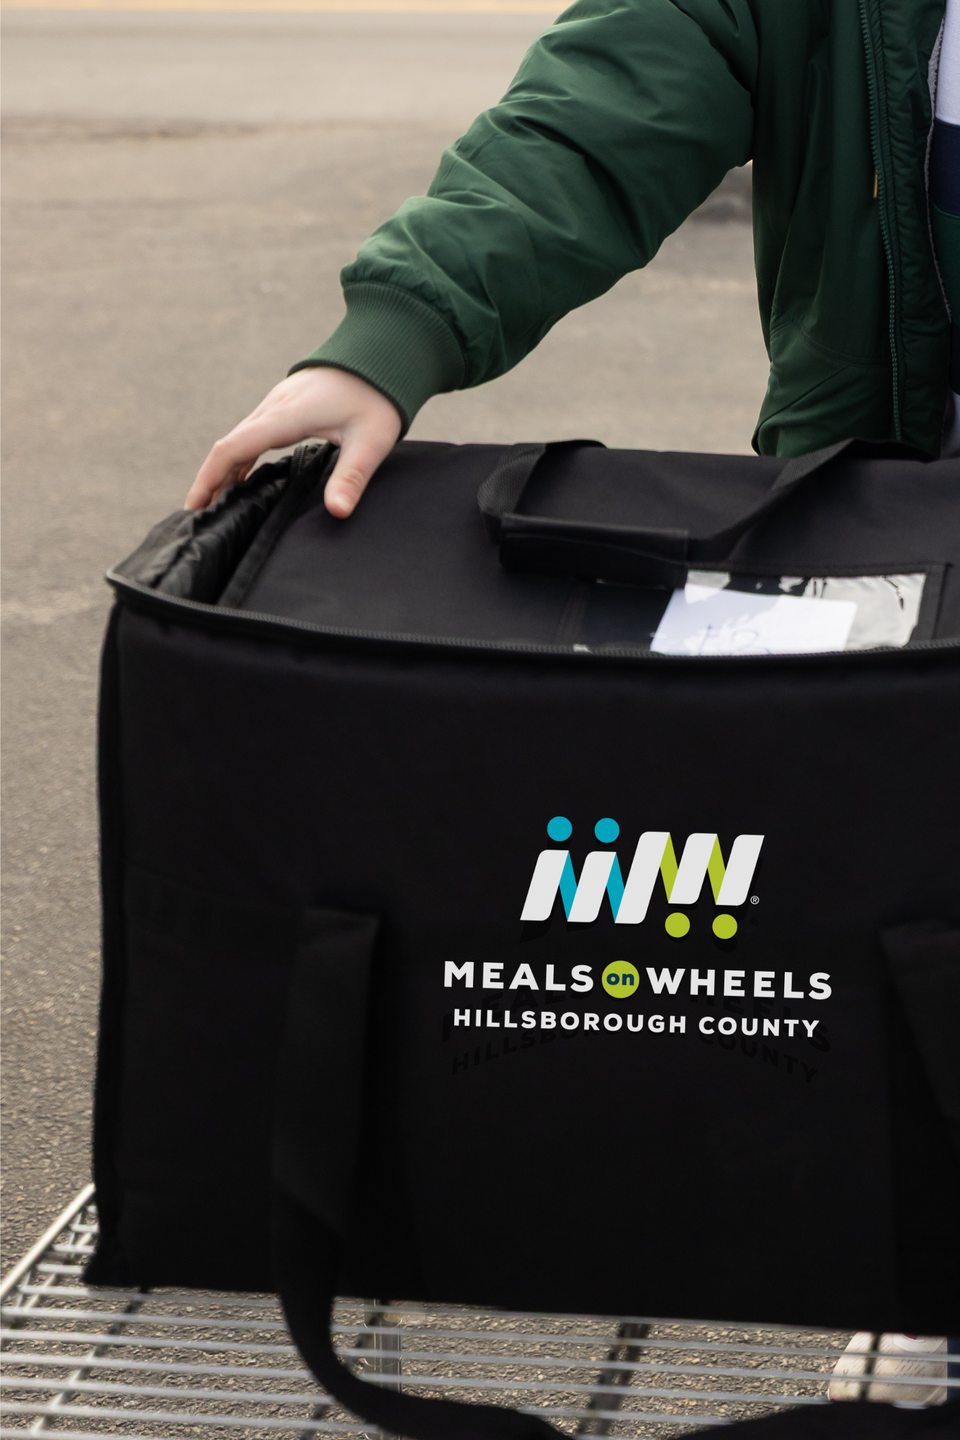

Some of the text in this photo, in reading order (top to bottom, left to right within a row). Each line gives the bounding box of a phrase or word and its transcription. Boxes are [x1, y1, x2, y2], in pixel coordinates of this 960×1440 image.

[444, 961, 832, 1000] MEALS on WHEELS
[453, 1008, 820, 1038] HILLSBOROUGH COUNTY
